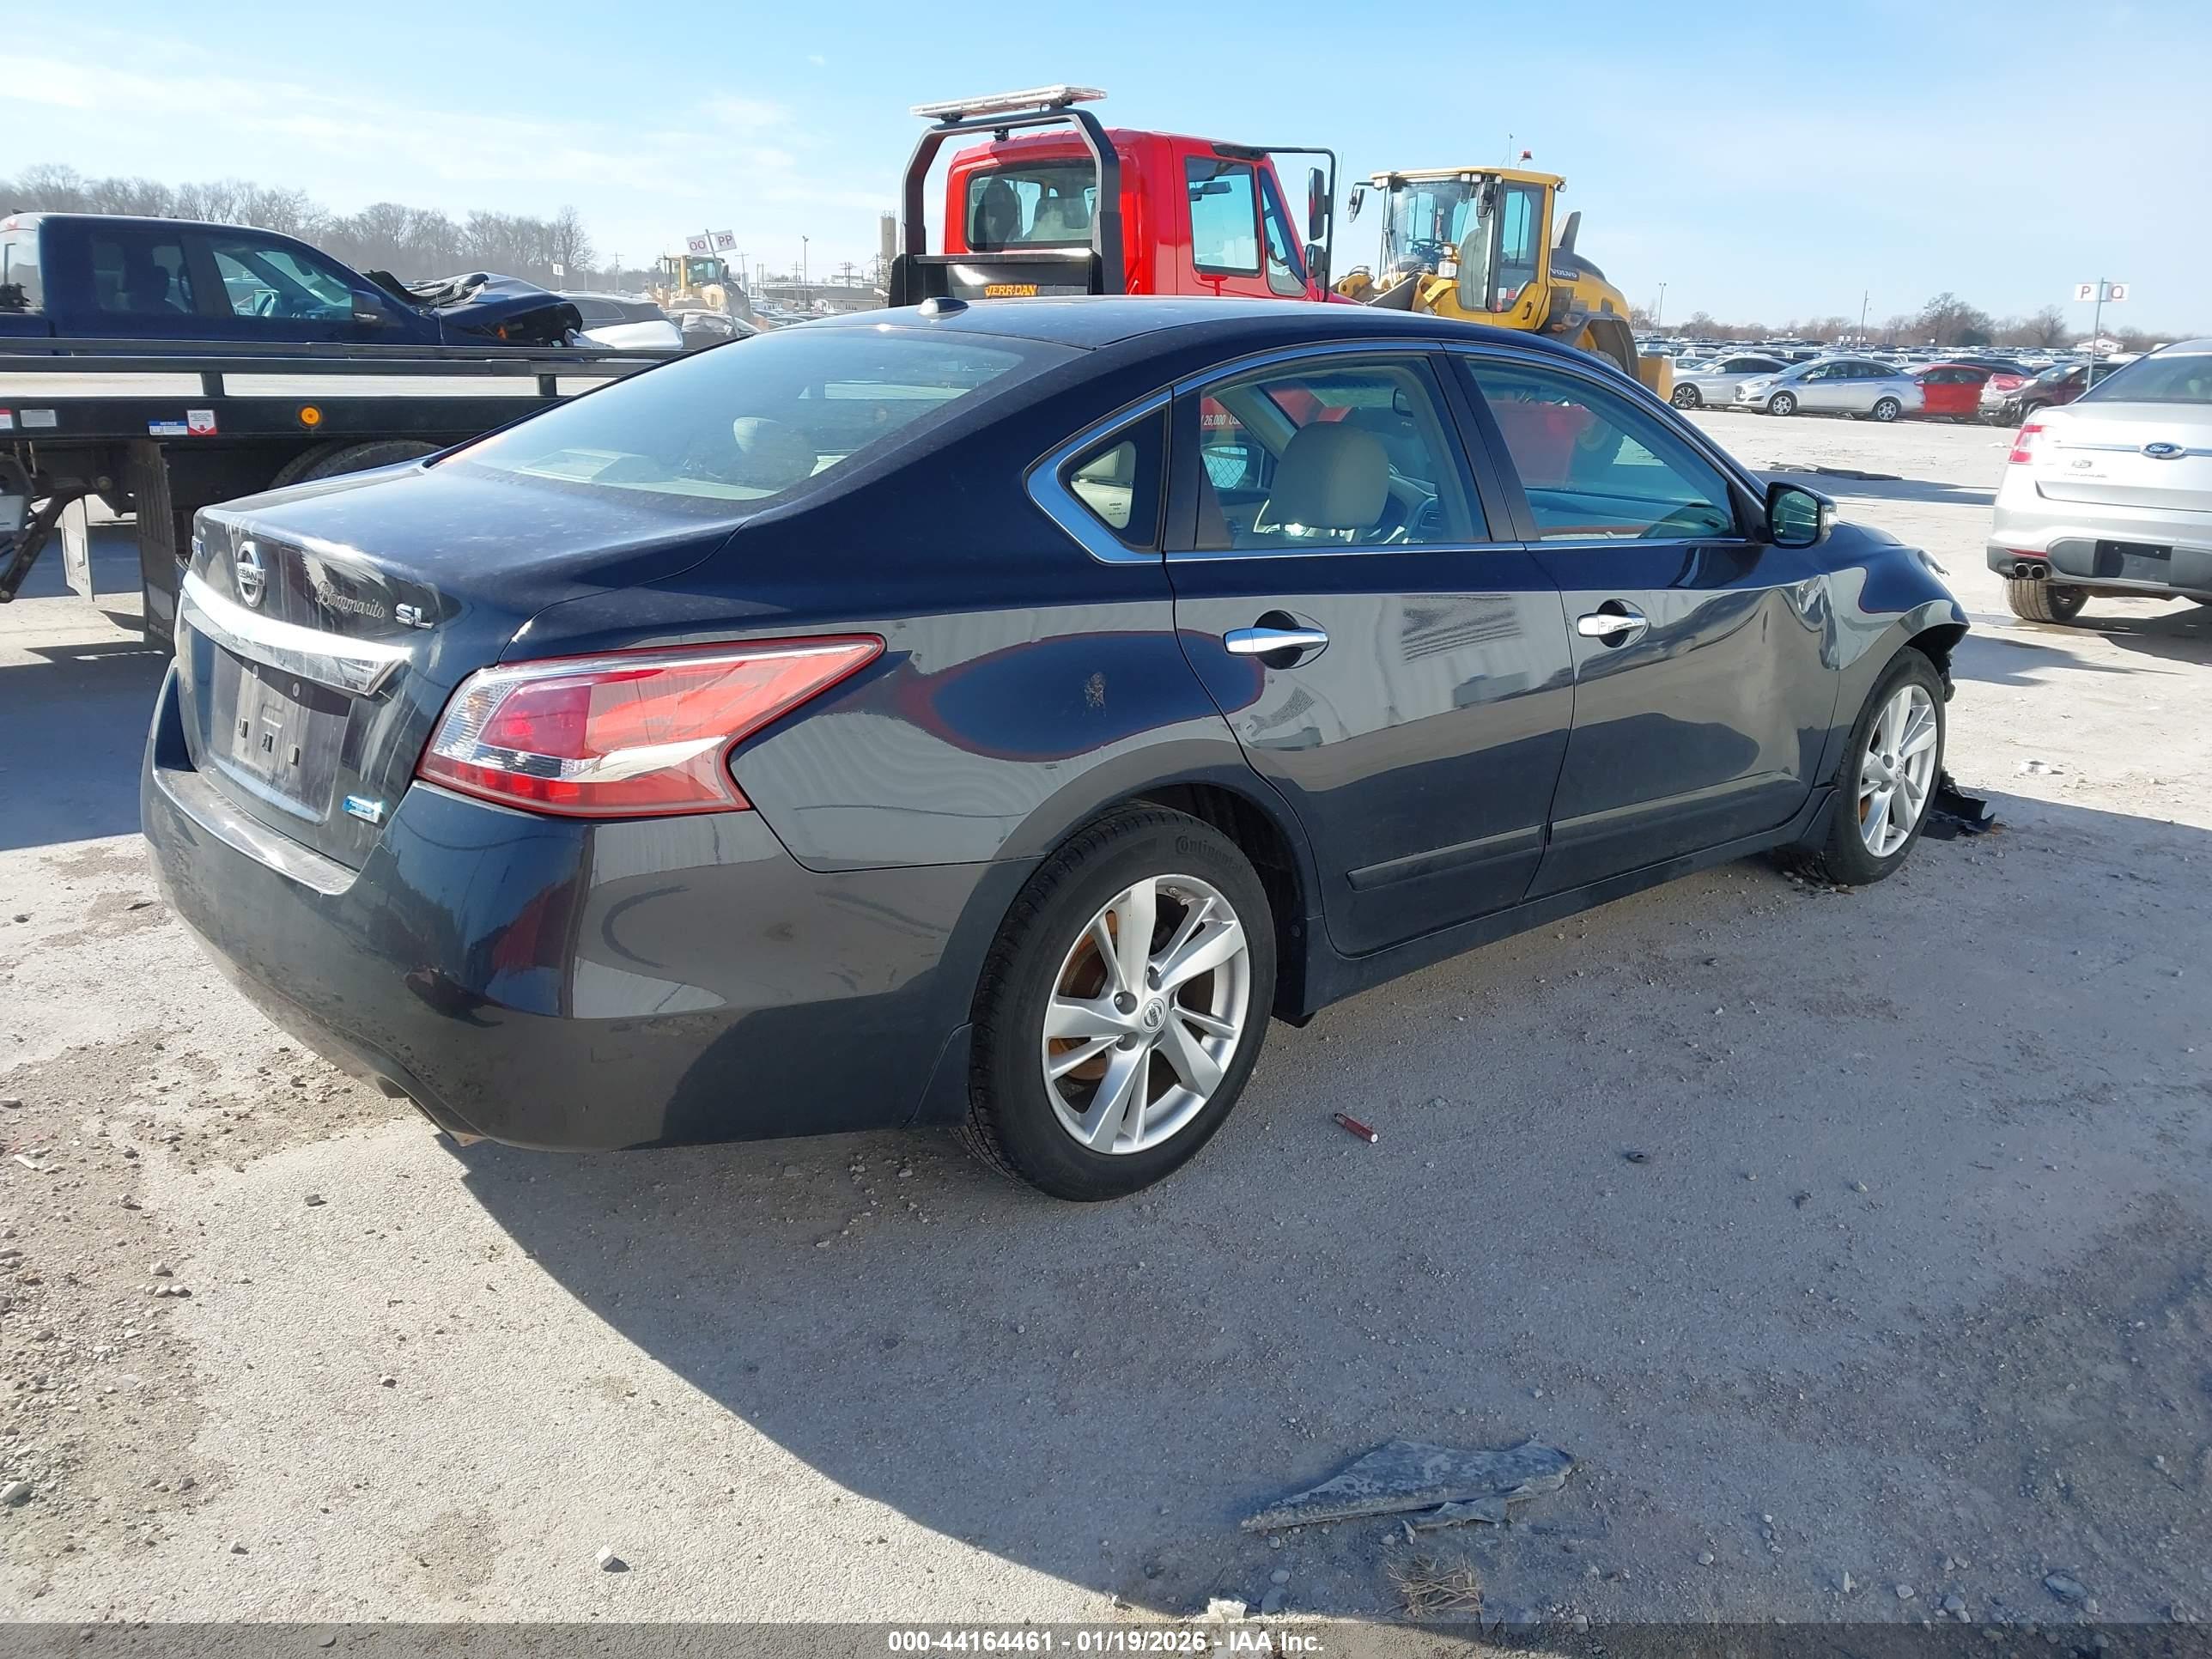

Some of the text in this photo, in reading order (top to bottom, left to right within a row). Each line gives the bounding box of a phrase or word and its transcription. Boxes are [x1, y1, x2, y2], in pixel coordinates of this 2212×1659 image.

[718, 234, 732, 246] PP
[1551, 268, 1577, 278] VOLVO
[2081, 285, 2091, 299] P
[2111, 285, 2124, 299] Q
[1203, 414, 1226, 427] 26,000
[395, 603, 434, 629] SL
